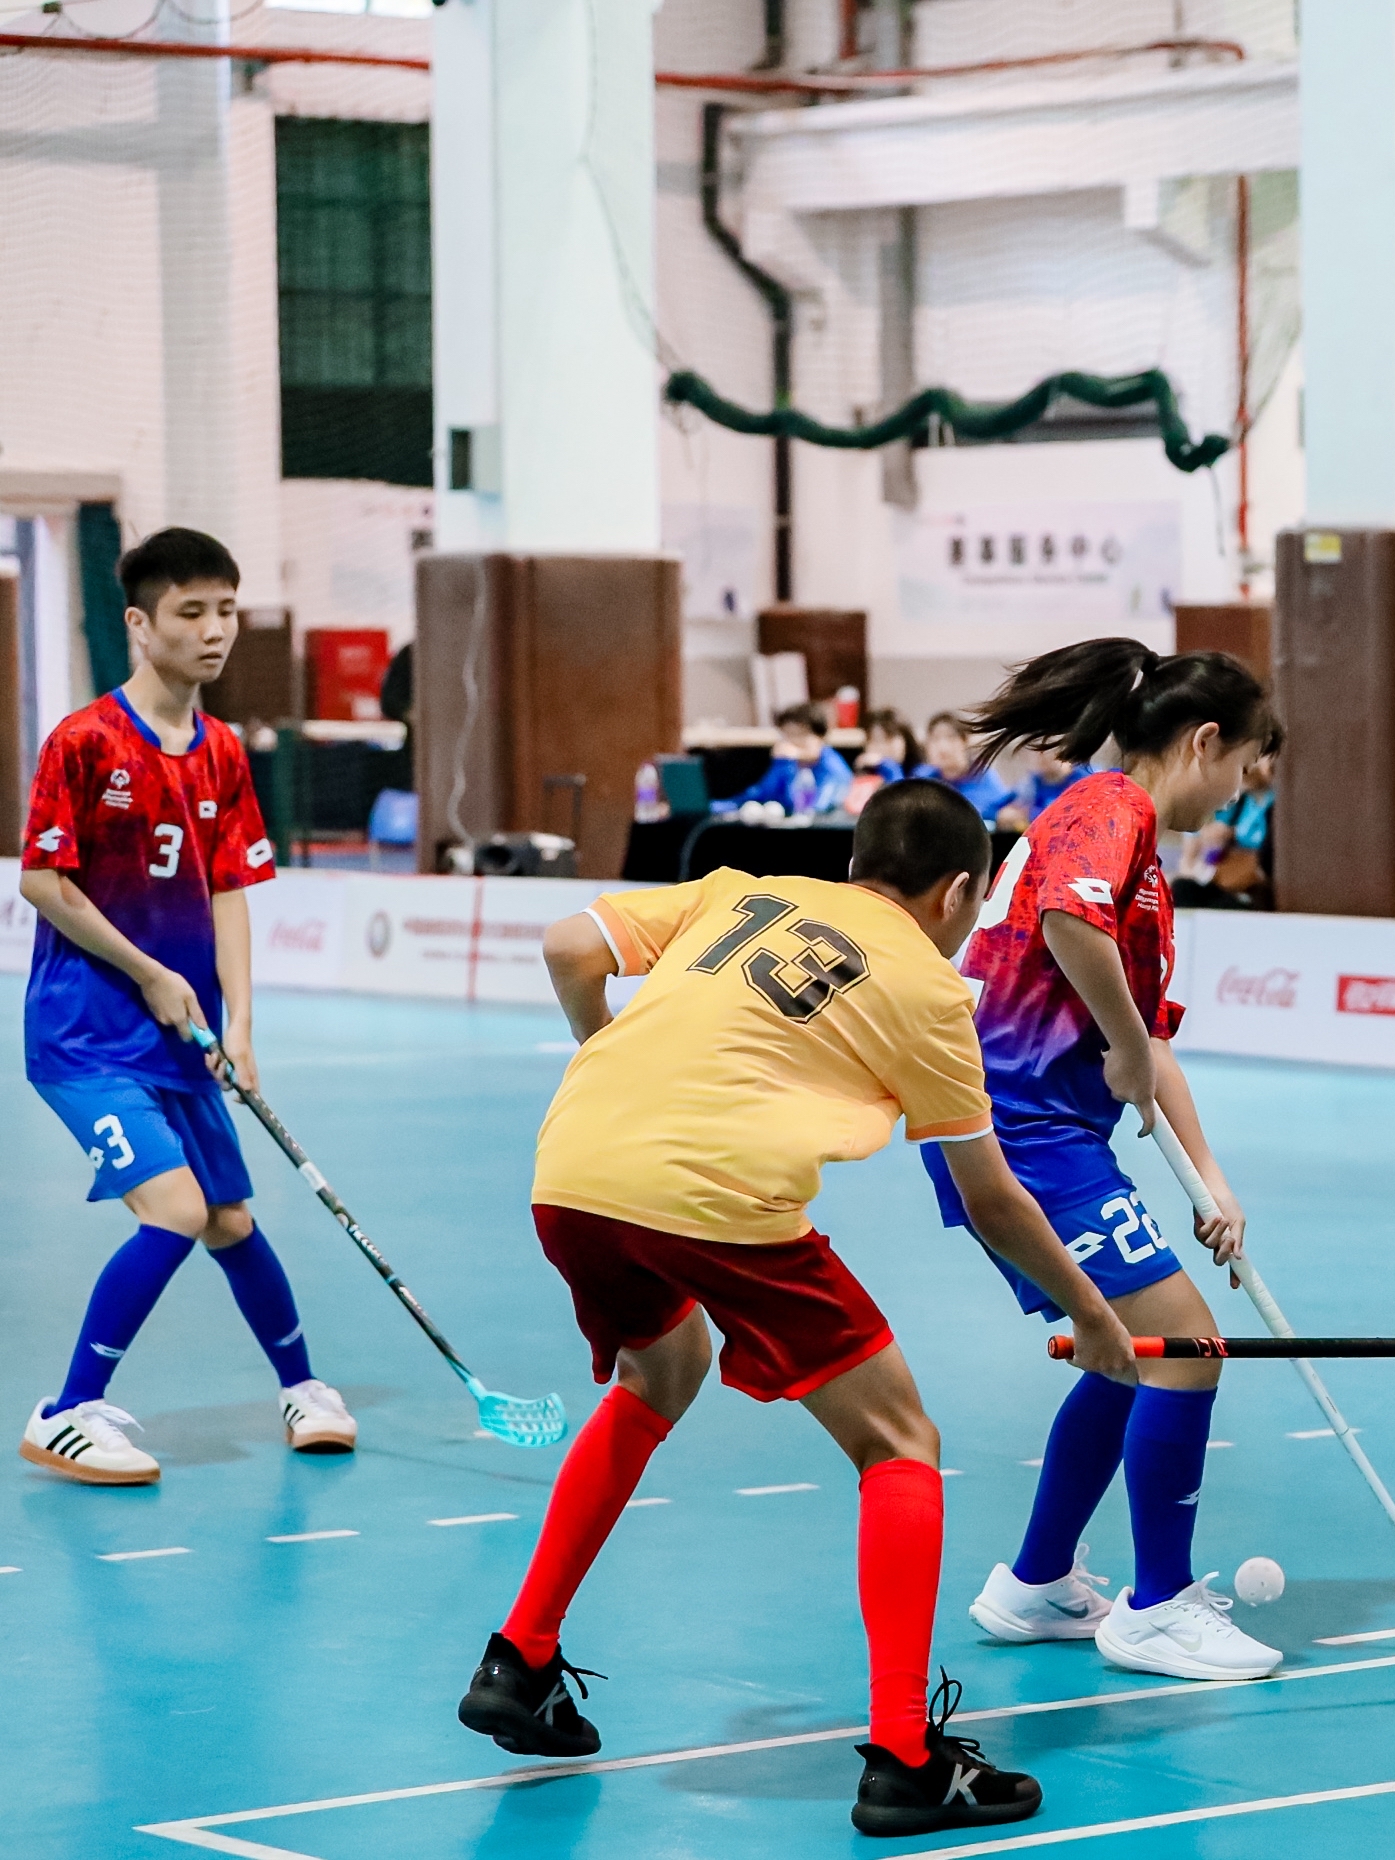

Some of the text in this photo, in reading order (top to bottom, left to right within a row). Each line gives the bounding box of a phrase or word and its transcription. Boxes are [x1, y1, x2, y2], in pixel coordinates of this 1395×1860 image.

[149, 823, 183, 878] 3
[686, 894, 871, 1024] 13
[93, 1113, 135, 1170] 3
